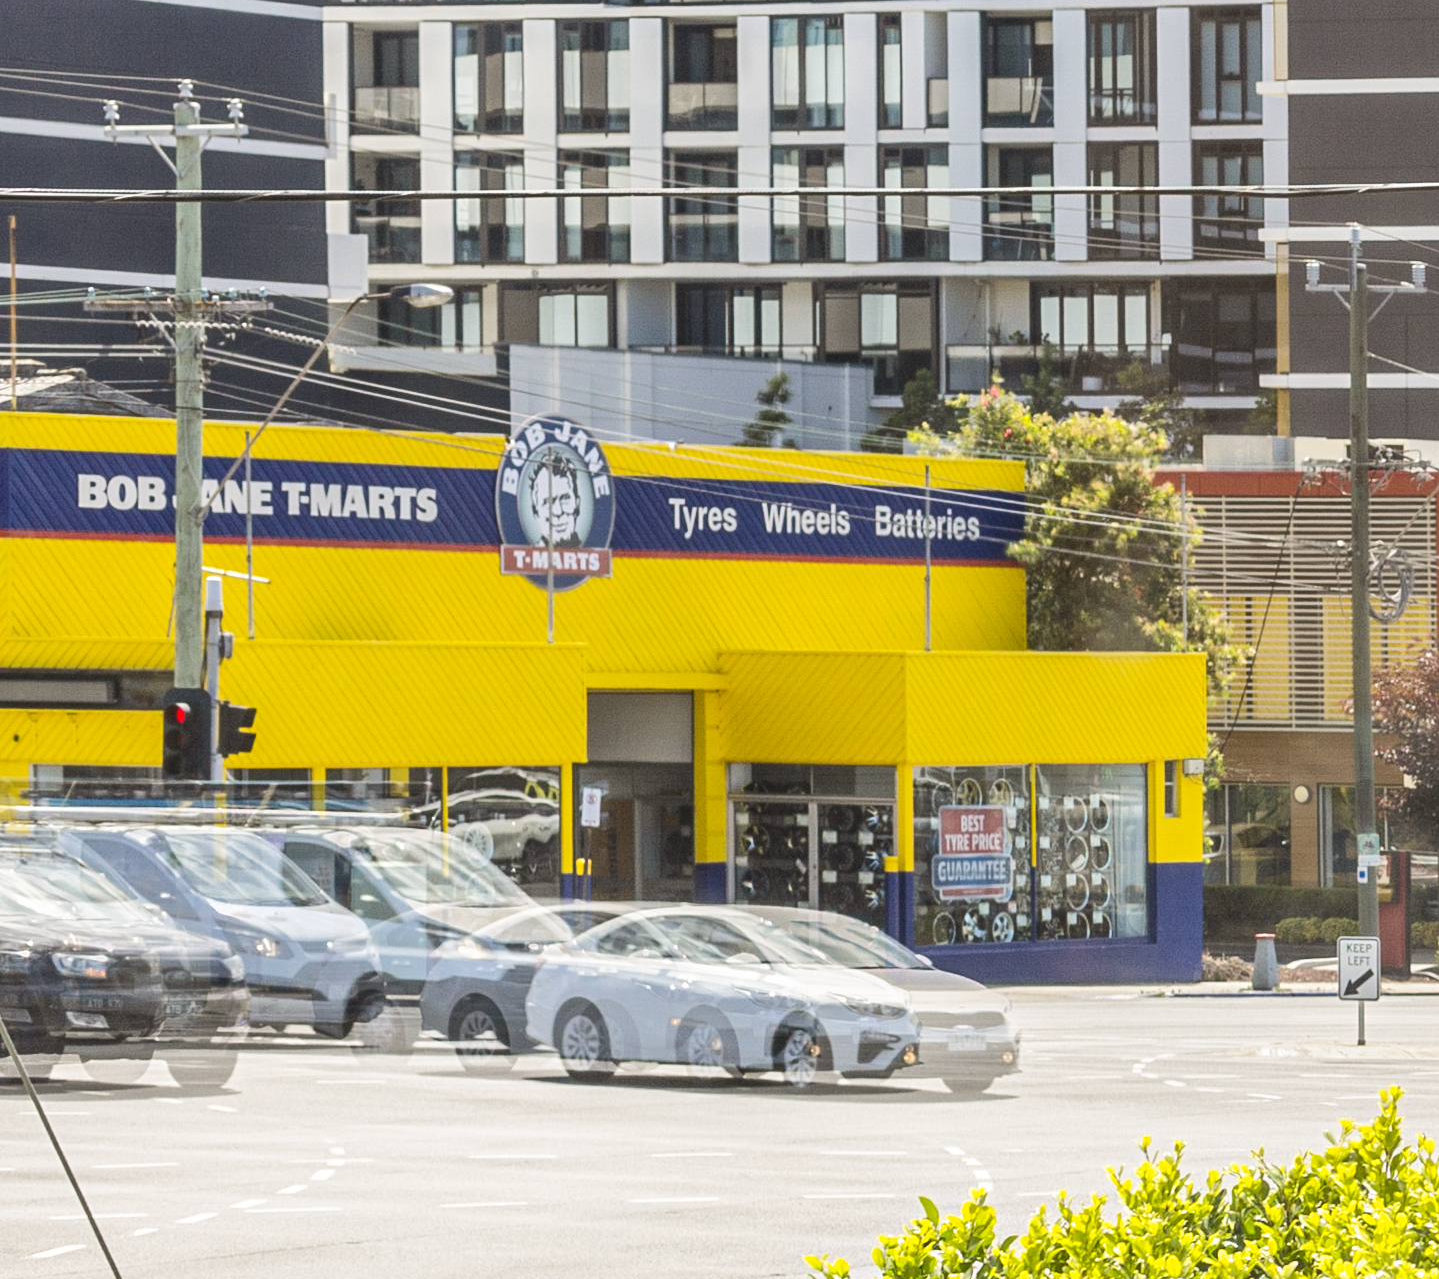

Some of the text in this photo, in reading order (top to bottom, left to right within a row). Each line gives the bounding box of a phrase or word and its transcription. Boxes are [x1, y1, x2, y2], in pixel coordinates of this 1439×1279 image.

[501, 420, 611, 499] BOB JANE
[77, 473, 439, 523] BOB ANE T-MARTS
[668, 497, 981, 541] Tyres Wheels Batteries
[960, 814, 985, 833] BEST
[944, 832, 1002, 852] TYRE PRICE
[938, 860, 1007, 882] GUARANTEE
[1346, 943, 1373, 954] KEEP
[1347, 956, 1371, 967] LEFT
